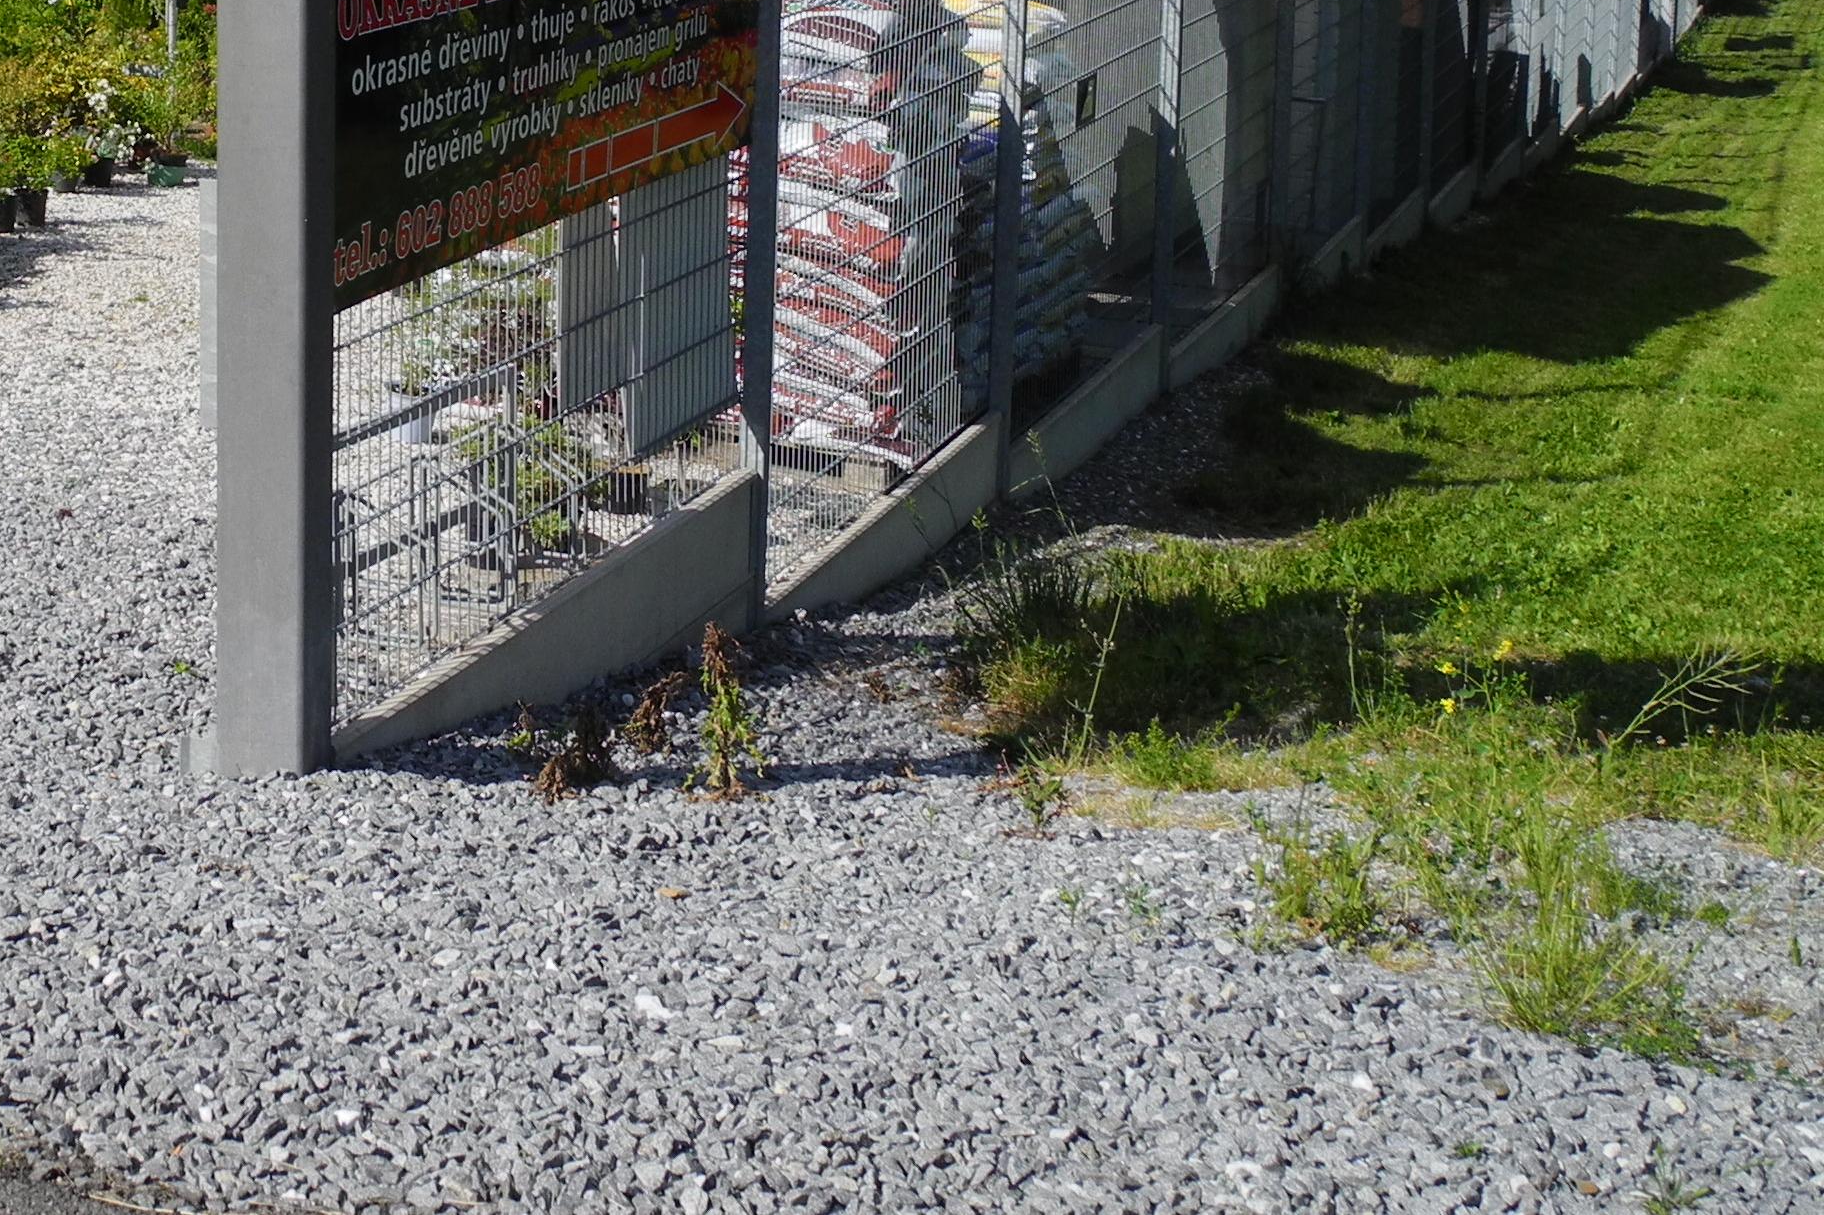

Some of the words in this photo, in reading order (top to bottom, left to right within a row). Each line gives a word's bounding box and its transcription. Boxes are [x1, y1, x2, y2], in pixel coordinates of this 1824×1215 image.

[351, 38, 432, 96] okrasné
[438, 23, 511, 72] dřeviny
[531, 2, 575, 45] thuje
[399, 75, 492, 133] substráty
[512, 48, 580, 96] truhlíky
[597, 21, 670, 73] pronájem
[675, 6, 708, 52] grilů
[404, 120, 484, 179] dřevěné
[489, 98, 562, 156] výrobky
[578, 70, 643, 118] skleníky
[660, 55, 701, 89] chaty
[333, 220, 390, 288] tel.:
[394, 198, 443, 260] 602
[447, 179, 494, 239] 888
[497, 161, 543, 219] 588
